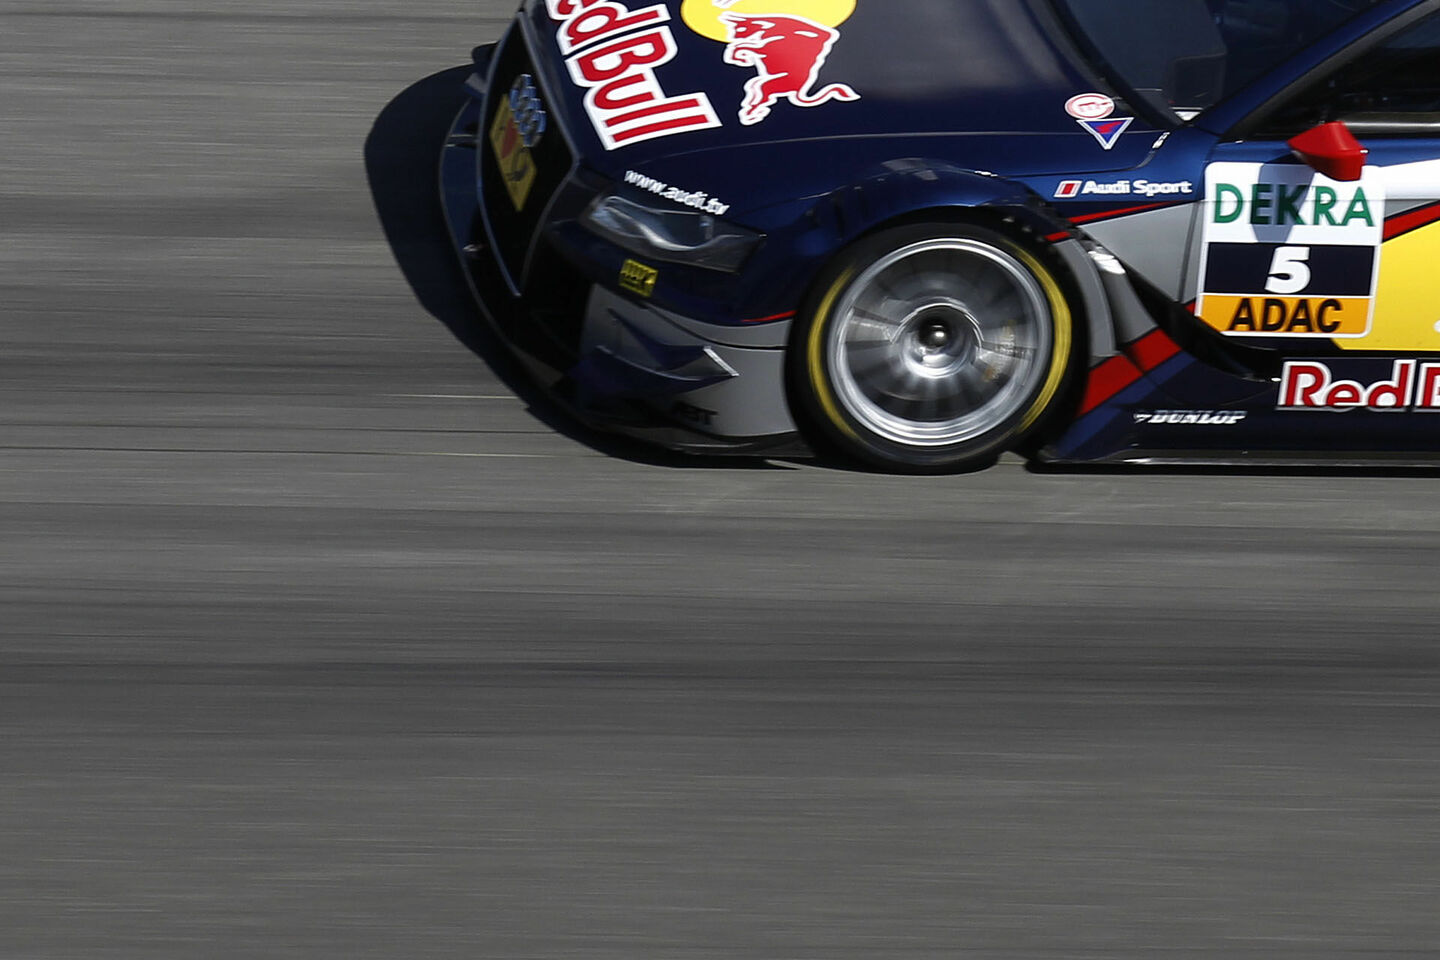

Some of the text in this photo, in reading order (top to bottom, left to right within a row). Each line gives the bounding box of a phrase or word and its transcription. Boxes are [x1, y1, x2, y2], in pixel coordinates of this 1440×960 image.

[1081, 179, 1193, 197] Audi Sport
[1213, 182, 1375, 227] DEKRA
[1264, 246, 1311, 294] 5
[1227, 297, 1344, 333] ADAC
[1146, 408, 1248, 424] DUNLOP
